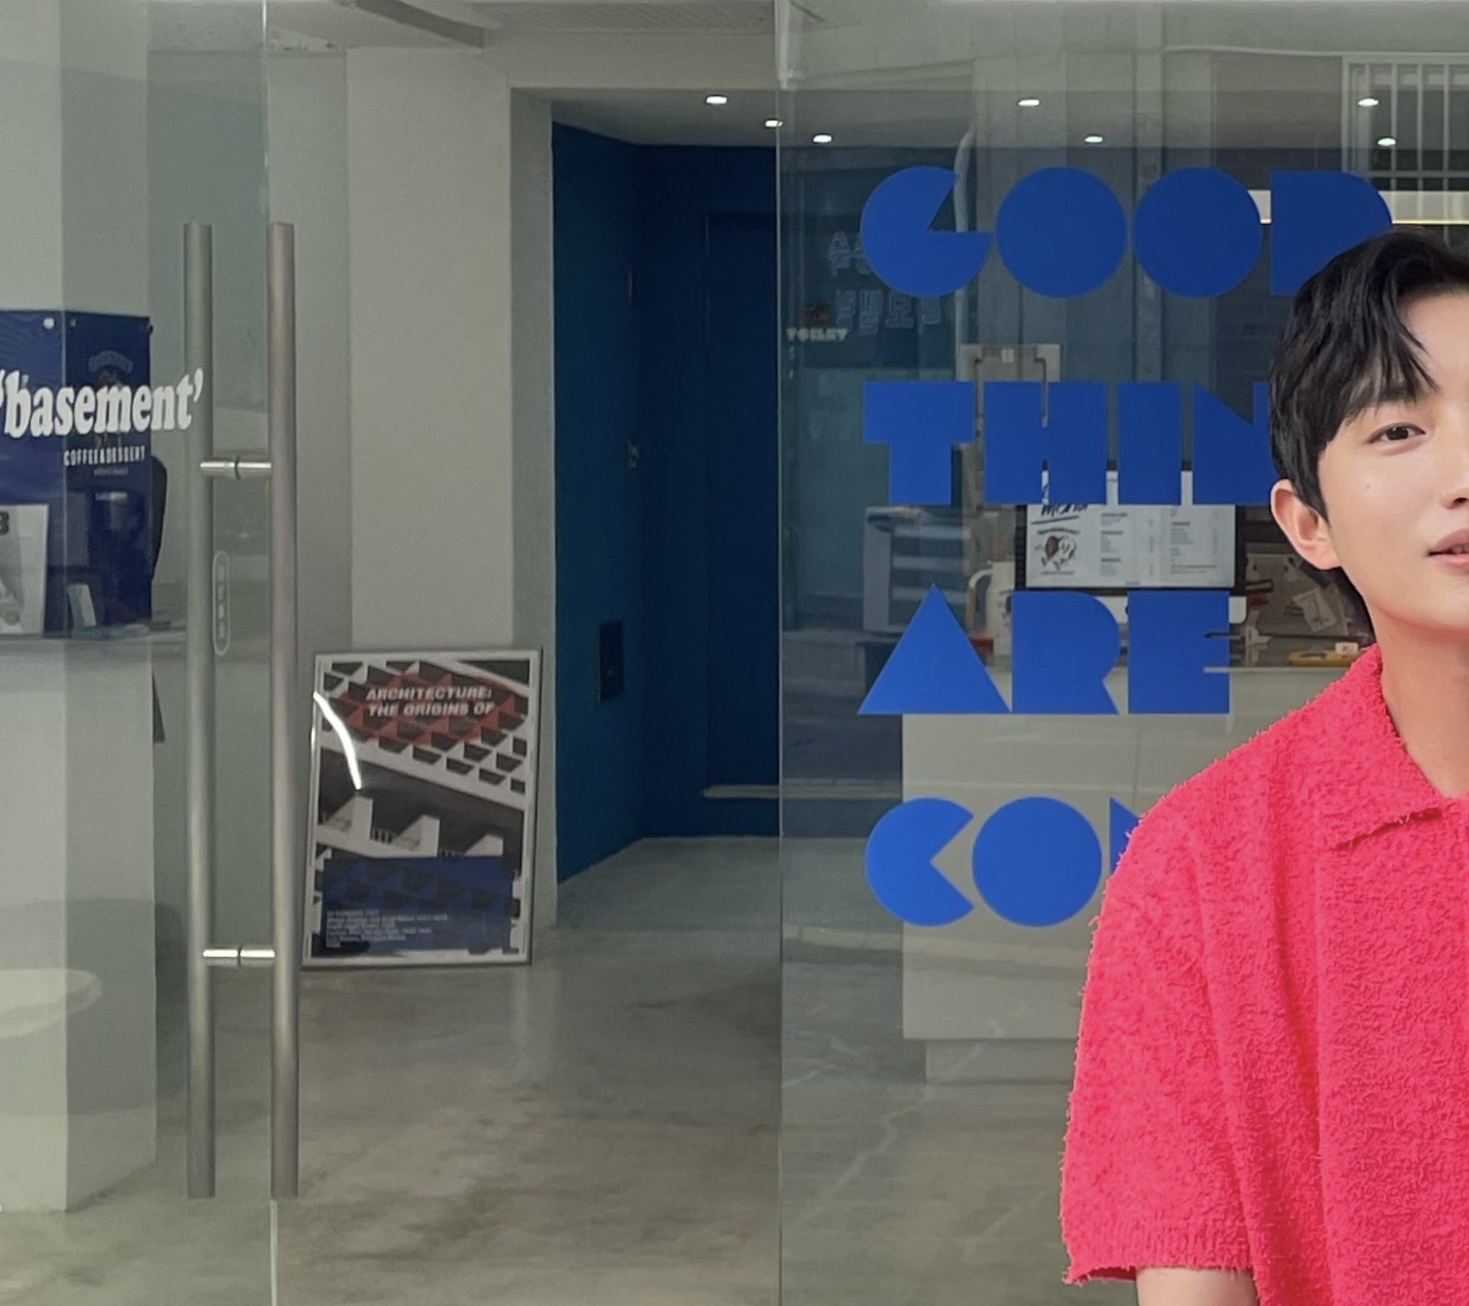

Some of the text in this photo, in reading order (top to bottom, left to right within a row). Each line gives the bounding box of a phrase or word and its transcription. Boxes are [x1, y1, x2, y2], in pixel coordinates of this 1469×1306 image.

[859, 165, 1393, 298] GOOD
[368, 700, 495, 718] THE ORIGINS OF
[857, 582, 1231, 714] ARE
